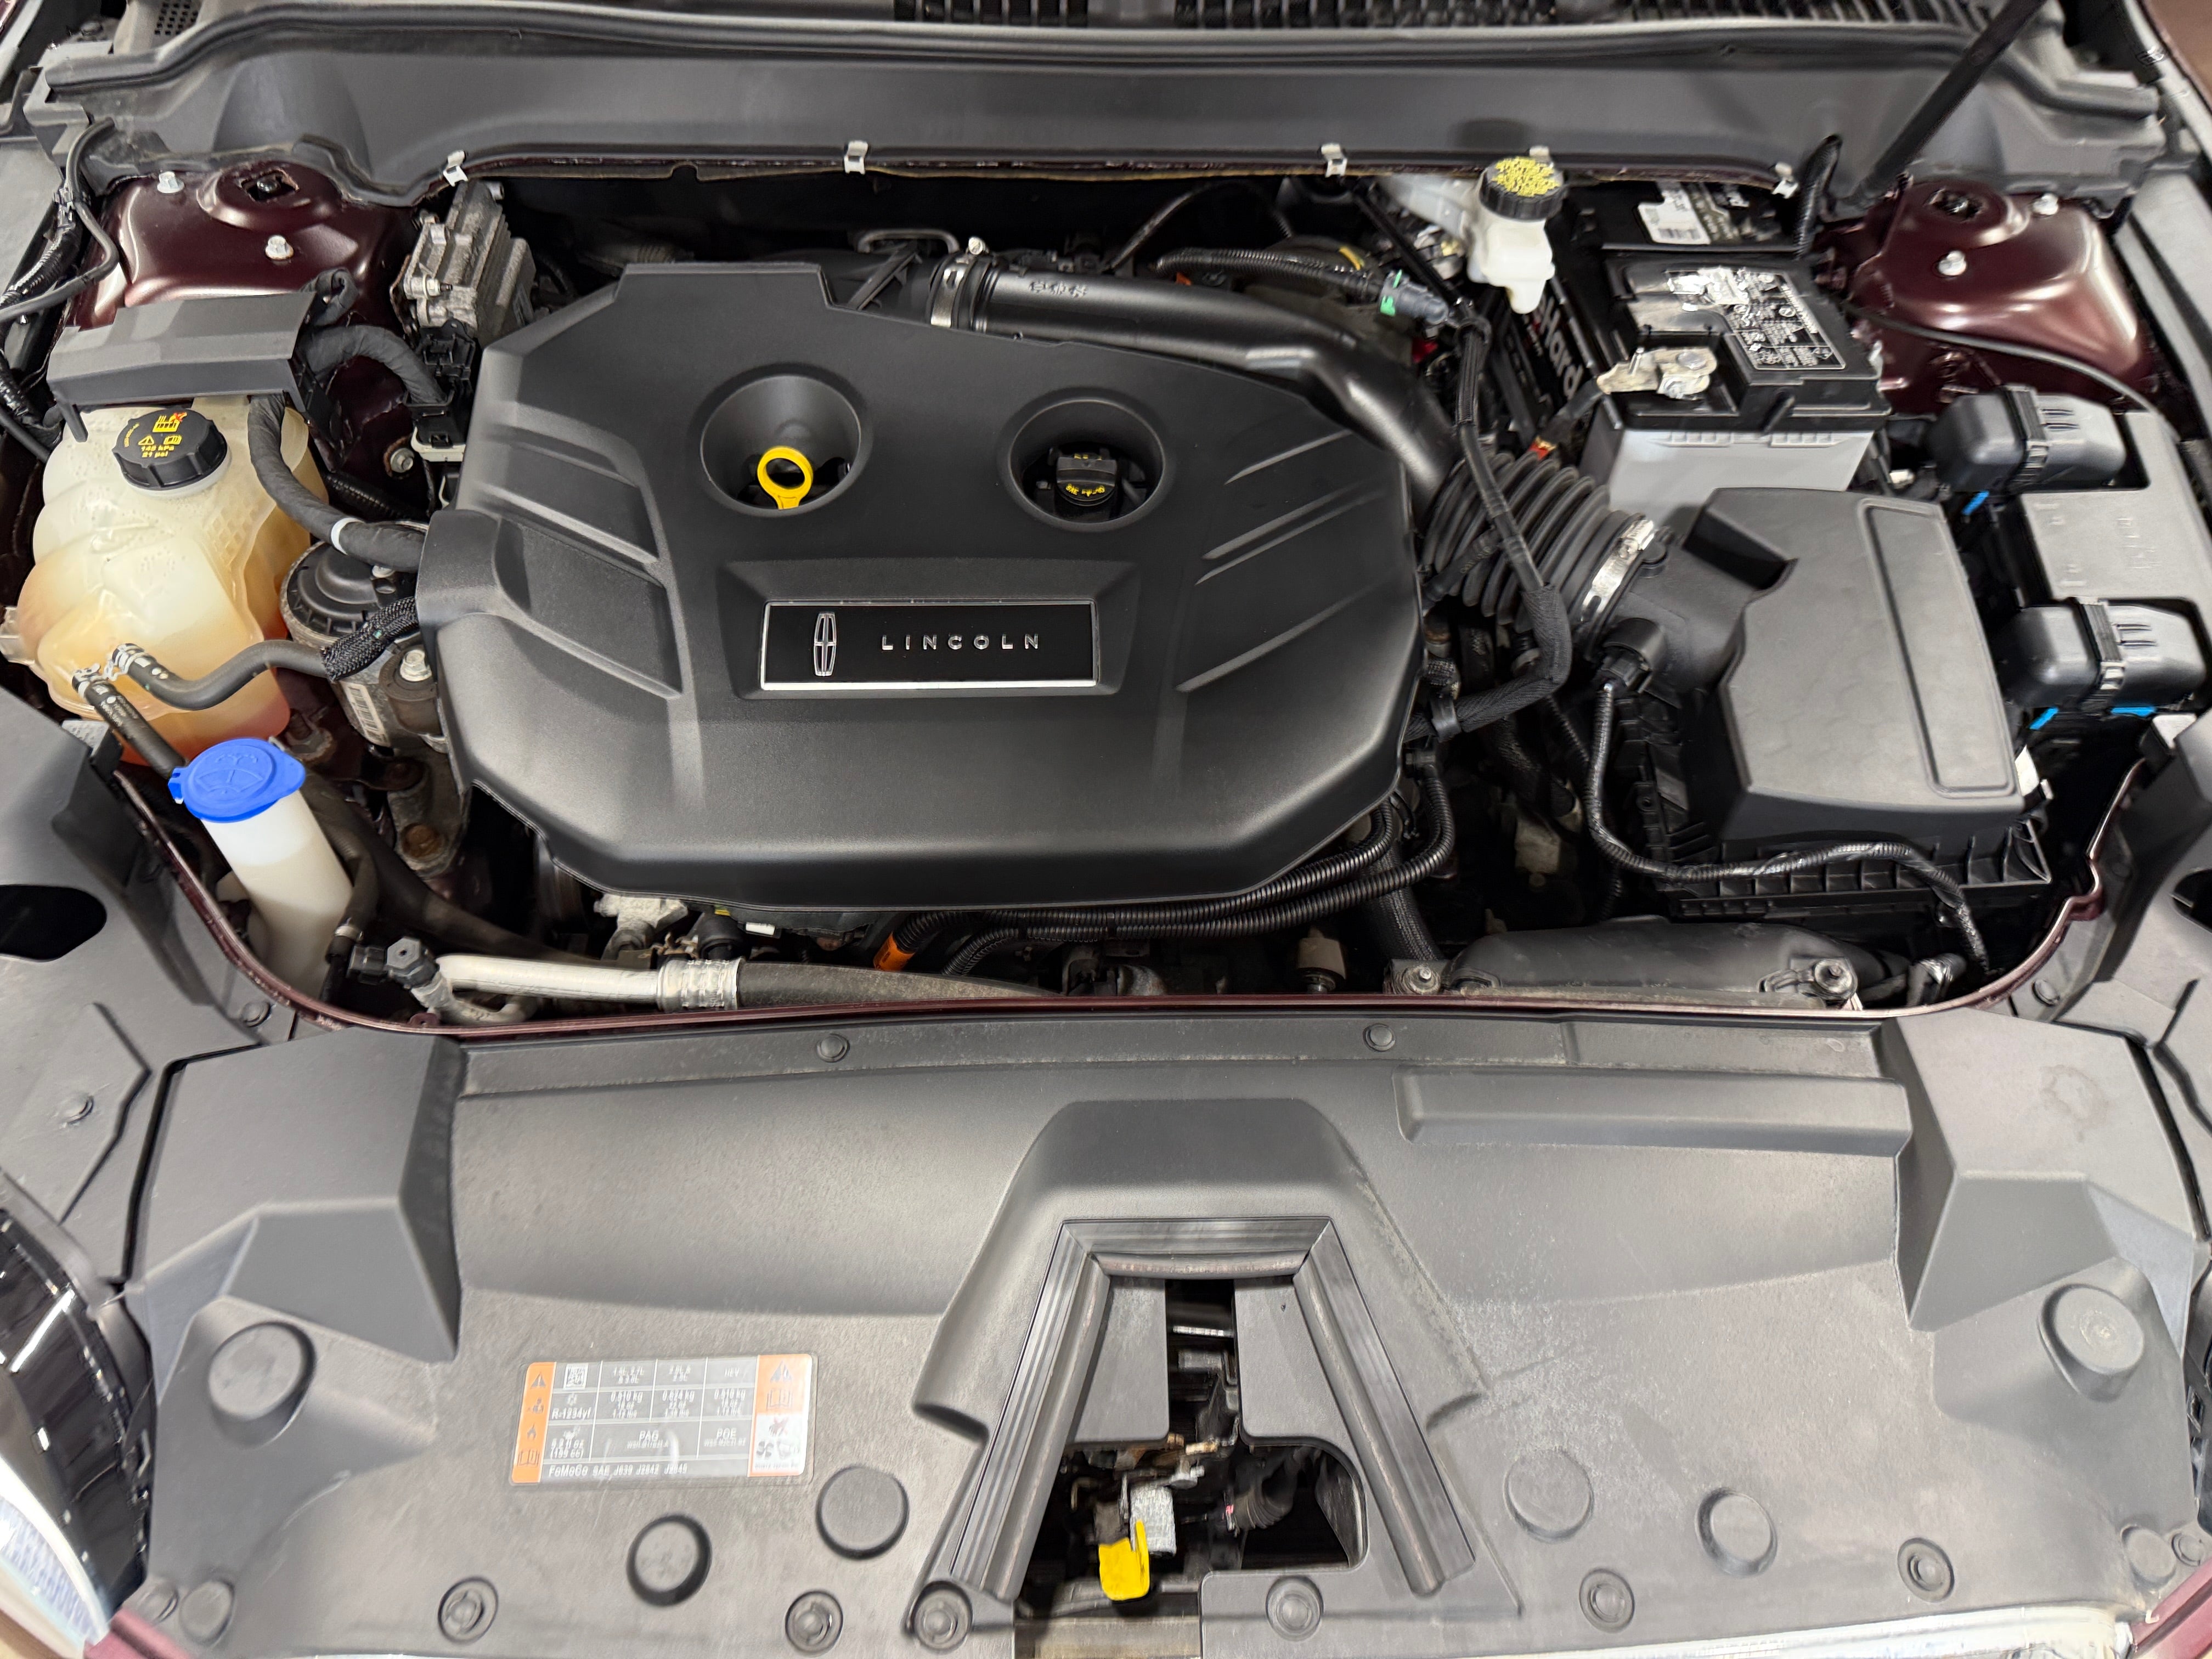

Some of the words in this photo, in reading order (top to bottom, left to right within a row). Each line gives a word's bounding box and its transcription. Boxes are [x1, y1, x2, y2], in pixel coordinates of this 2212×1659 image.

[1065, 483, 1080, 495] SAE
[881, 634, 1039, 651] LINCOLN
[633, 1390, 643, 1403] kg
[685, 1390, 695, 1402] kg
[736, 1389, 746, 1401] kg
[551, 1407, 591, 1420] R-1234yf
[639, 1430, 659, 1441] PAG
[716, 1427, 737, 1439] POE
[549, 1463, 588, 1477] FoMoCo
[592, 1464, 610, 1476] SAE
